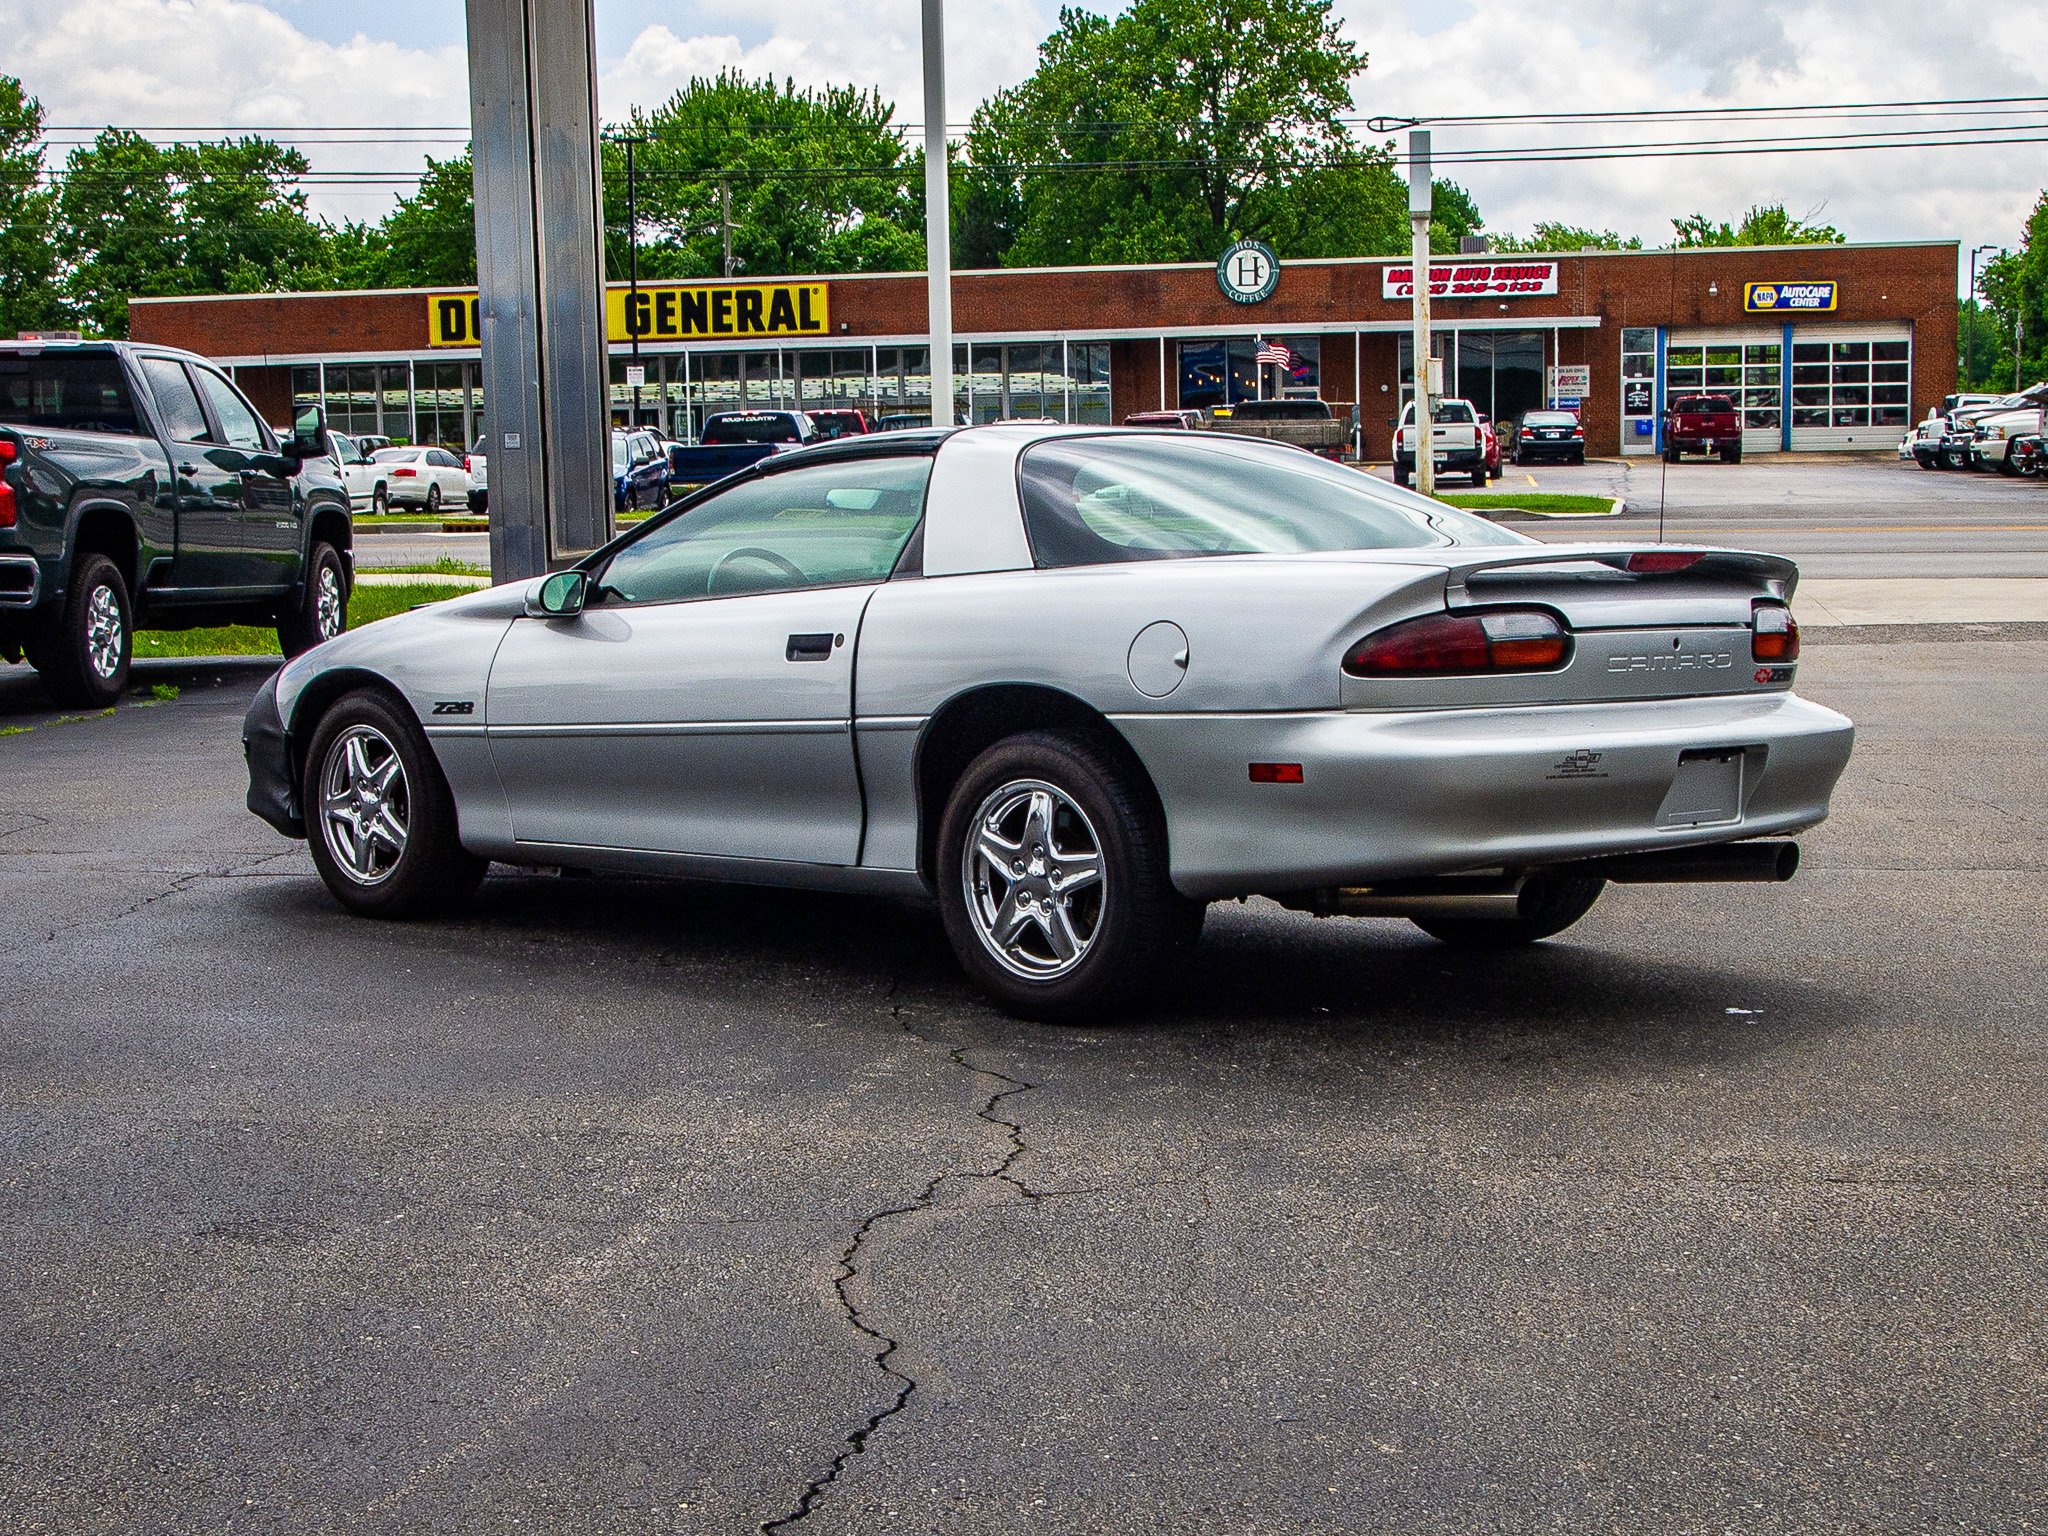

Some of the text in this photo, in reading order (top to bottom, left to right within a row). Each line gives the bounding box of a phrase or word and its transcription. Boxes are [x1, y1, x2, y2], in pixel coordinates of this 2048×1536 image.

[1453, 267, 1491, 281] AUTO
[1492, 265, 1552, 281] SERVICE
[1228, 289, 1268, 303] COFFEE
[1756, 291, 1775, 302] NAPA
[1789, 298, 1820, 307] CENTER
[624, 287, 820, 336] GENERAL
[1607, 652, 1732, 673] CAMARO
[432, 701, 474, 715] Z28
